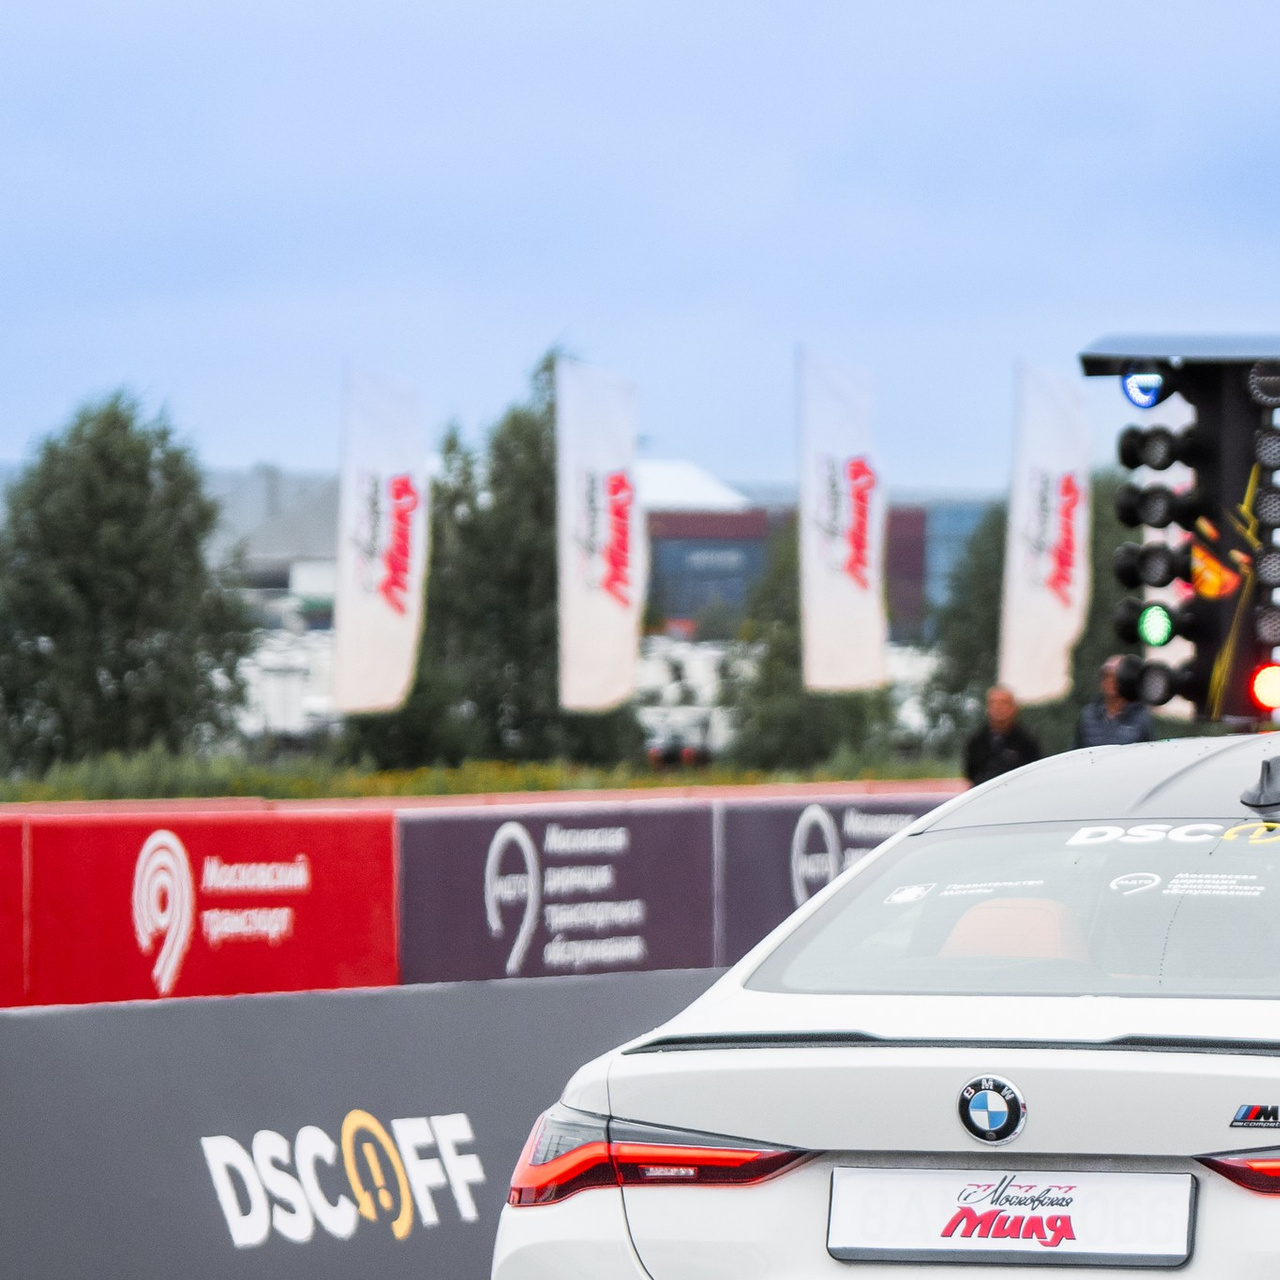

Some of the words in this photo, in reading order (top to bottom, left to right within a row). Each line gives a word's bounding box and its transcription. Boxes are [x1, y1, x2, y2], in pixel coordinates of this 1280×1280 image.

[963, 1078, 1014, 1101] BMW
[957, 1174, 1073, 1210] Московская
[941, 1206, 1076, 1247] Миля
